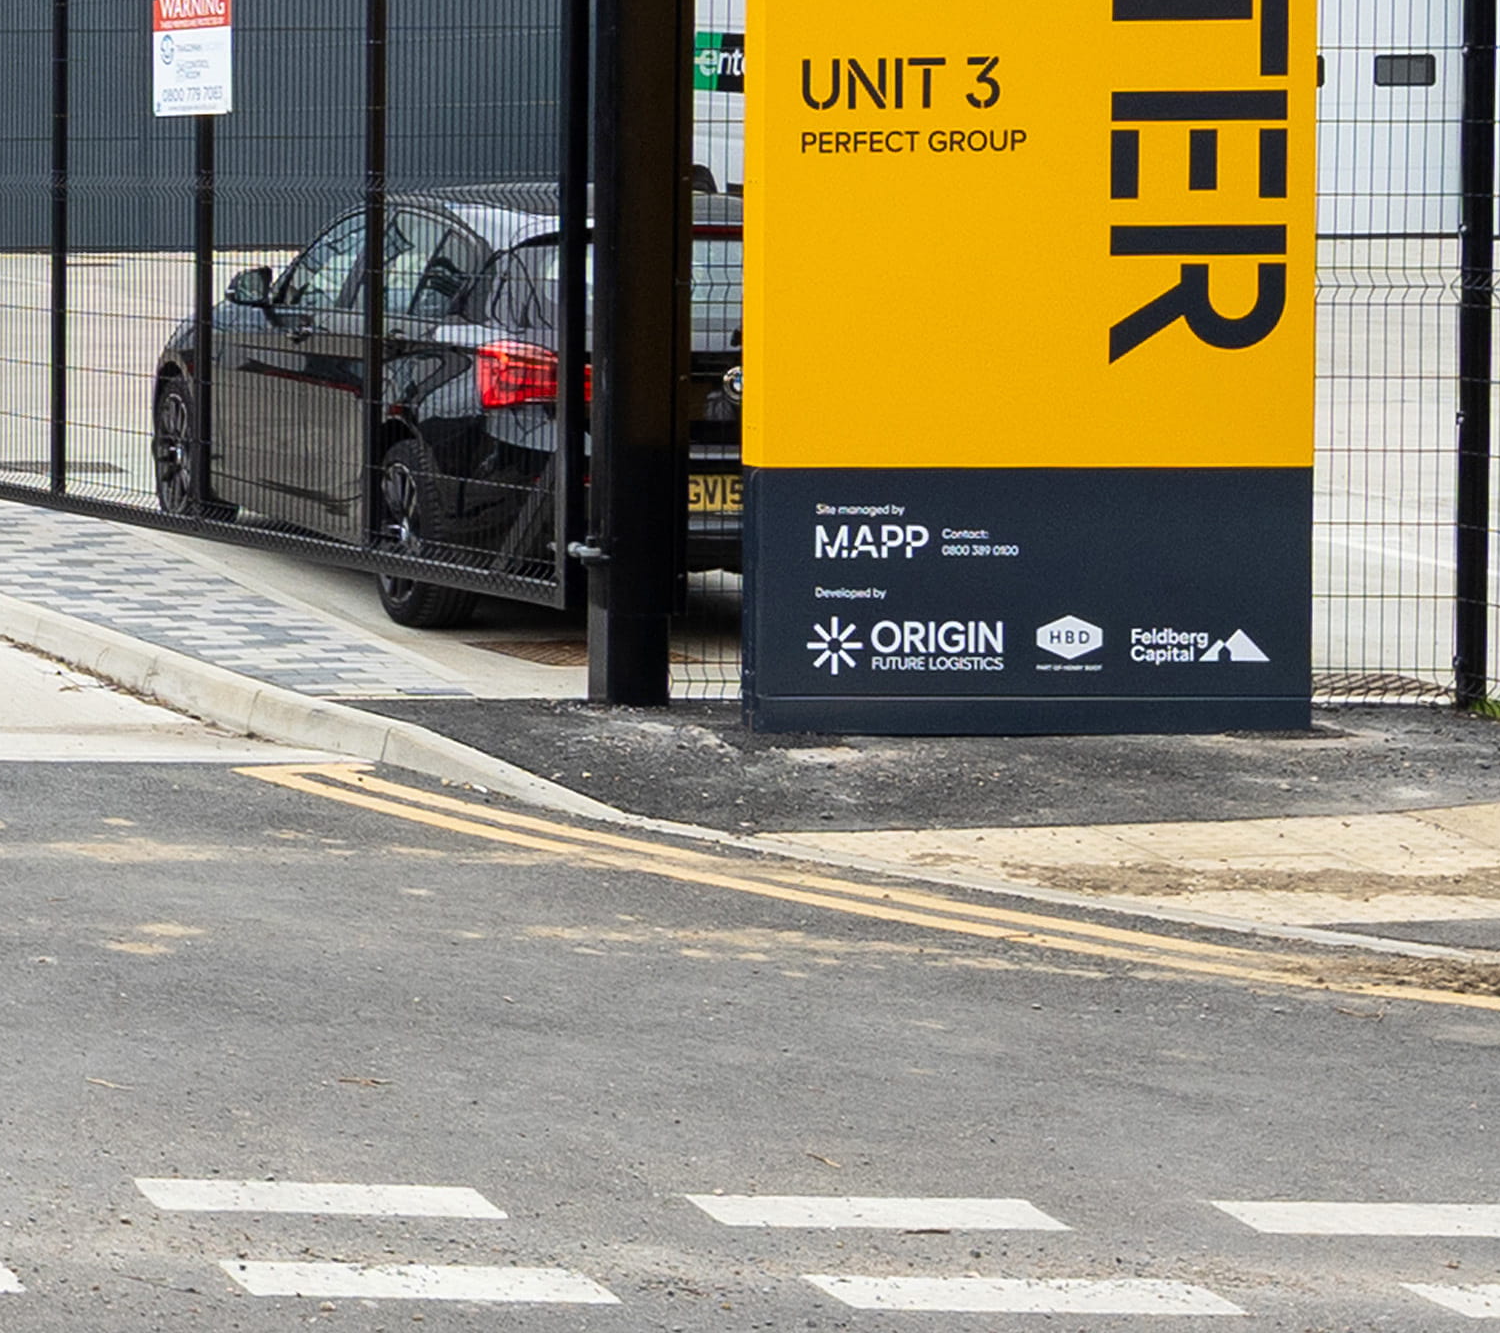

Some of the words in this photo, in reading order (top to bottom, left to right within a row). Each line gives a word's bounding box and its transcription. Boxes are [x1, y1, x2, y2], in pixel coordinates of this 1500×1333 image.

[699, 49, 745, 76] ent
[801, 56, 946, 109] UNIT
[965, 55, 1001, 109] 3
[801, 130, 920, 153] PERFECT
[928, 129, 1026, 153] GROUP
[816, 503, 836, 515] Site
[838, 504, 889, 517] managed
[891, 504, 905, 517] by
[815, 524, 930, 559] MAPP
[941, 545, 969, 556] 0800
[815, 586, 872, 600] Developed
[873, 587, 887, 600] by
[870, 620, 1004, 654] ORIGIN
[1049, 630, 1090, 645] HBD
[1131, 628, 1208, 647] Feldberg
[872, 656, 925, 671] FUTURE
[928, 656, 1004, 671] LOGISTICS
[1131, 645, 1194, 666] Capital
